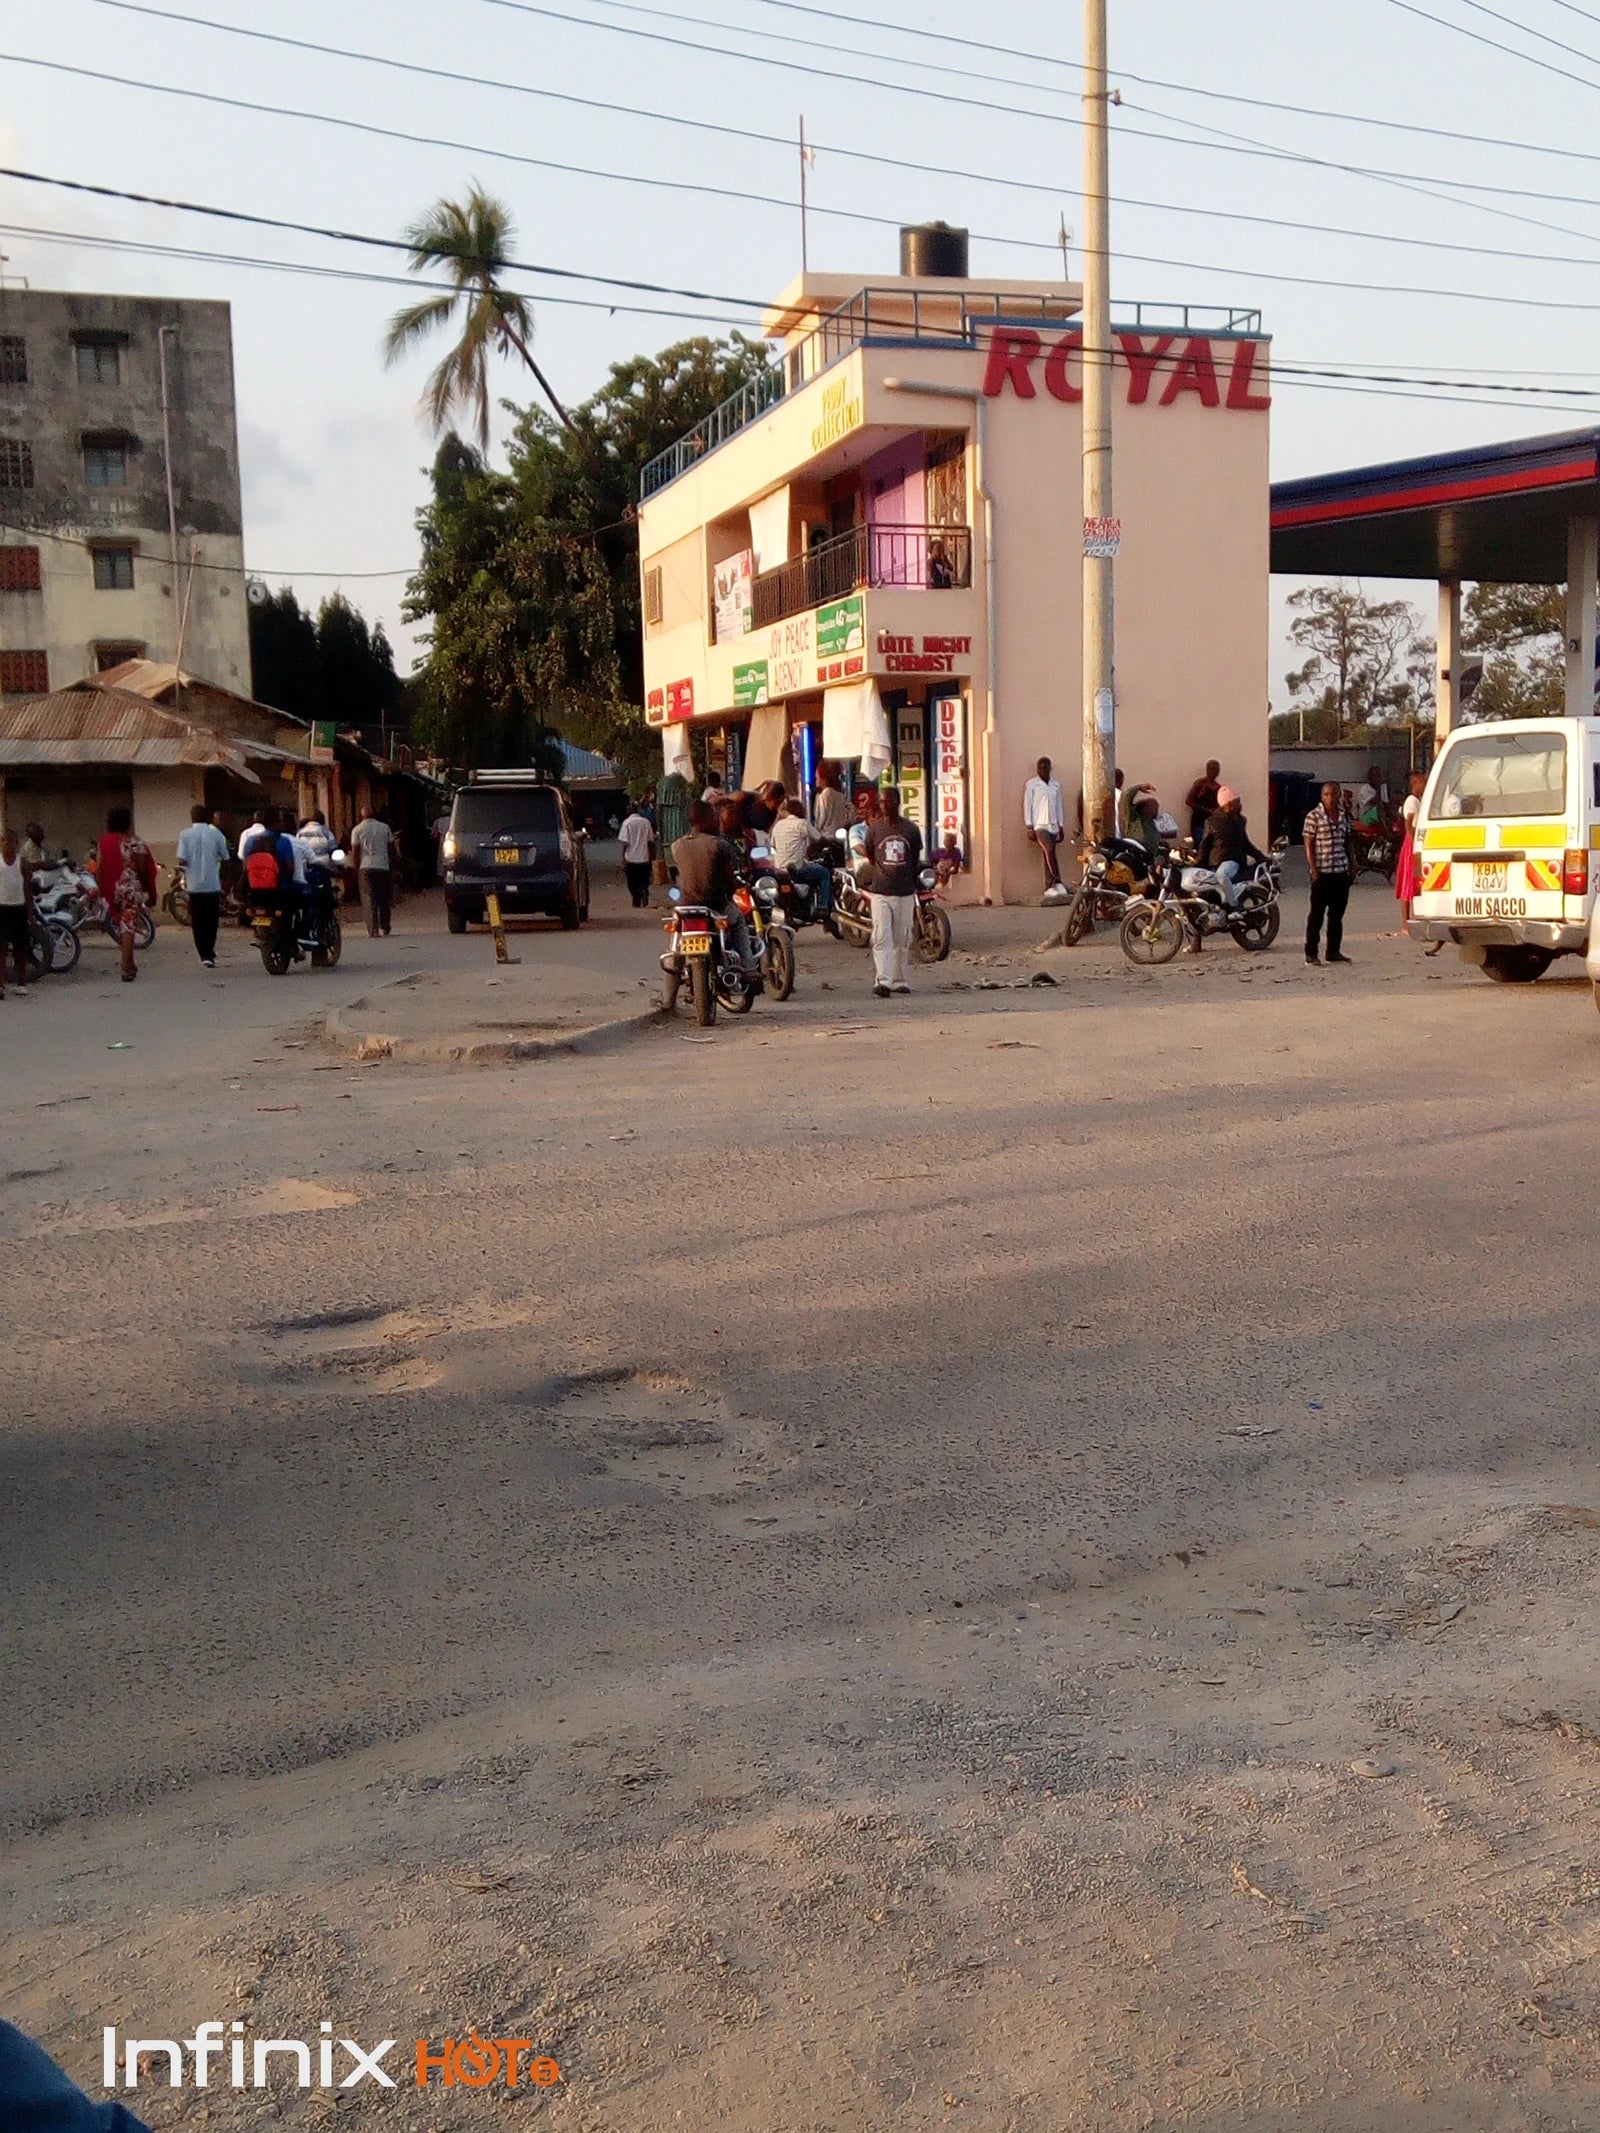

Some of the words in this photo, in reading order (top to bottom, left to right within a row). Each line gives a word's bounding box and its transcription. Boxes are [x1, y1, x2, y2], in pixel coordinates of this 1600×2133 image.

[983, 327, 1271, 409] ROYAL
[769, 629, 782, 660] JOY
[785, 617, 809, 655] PEACE
[774, 657, 803, 693] AGENCY
[885, 654, 954, 672] CHEMIST
[940, 701, 956, 773] DUKA
[1455, 897, 1482, 915] MOM
[1486, 897, 1526, 916] SACCO
